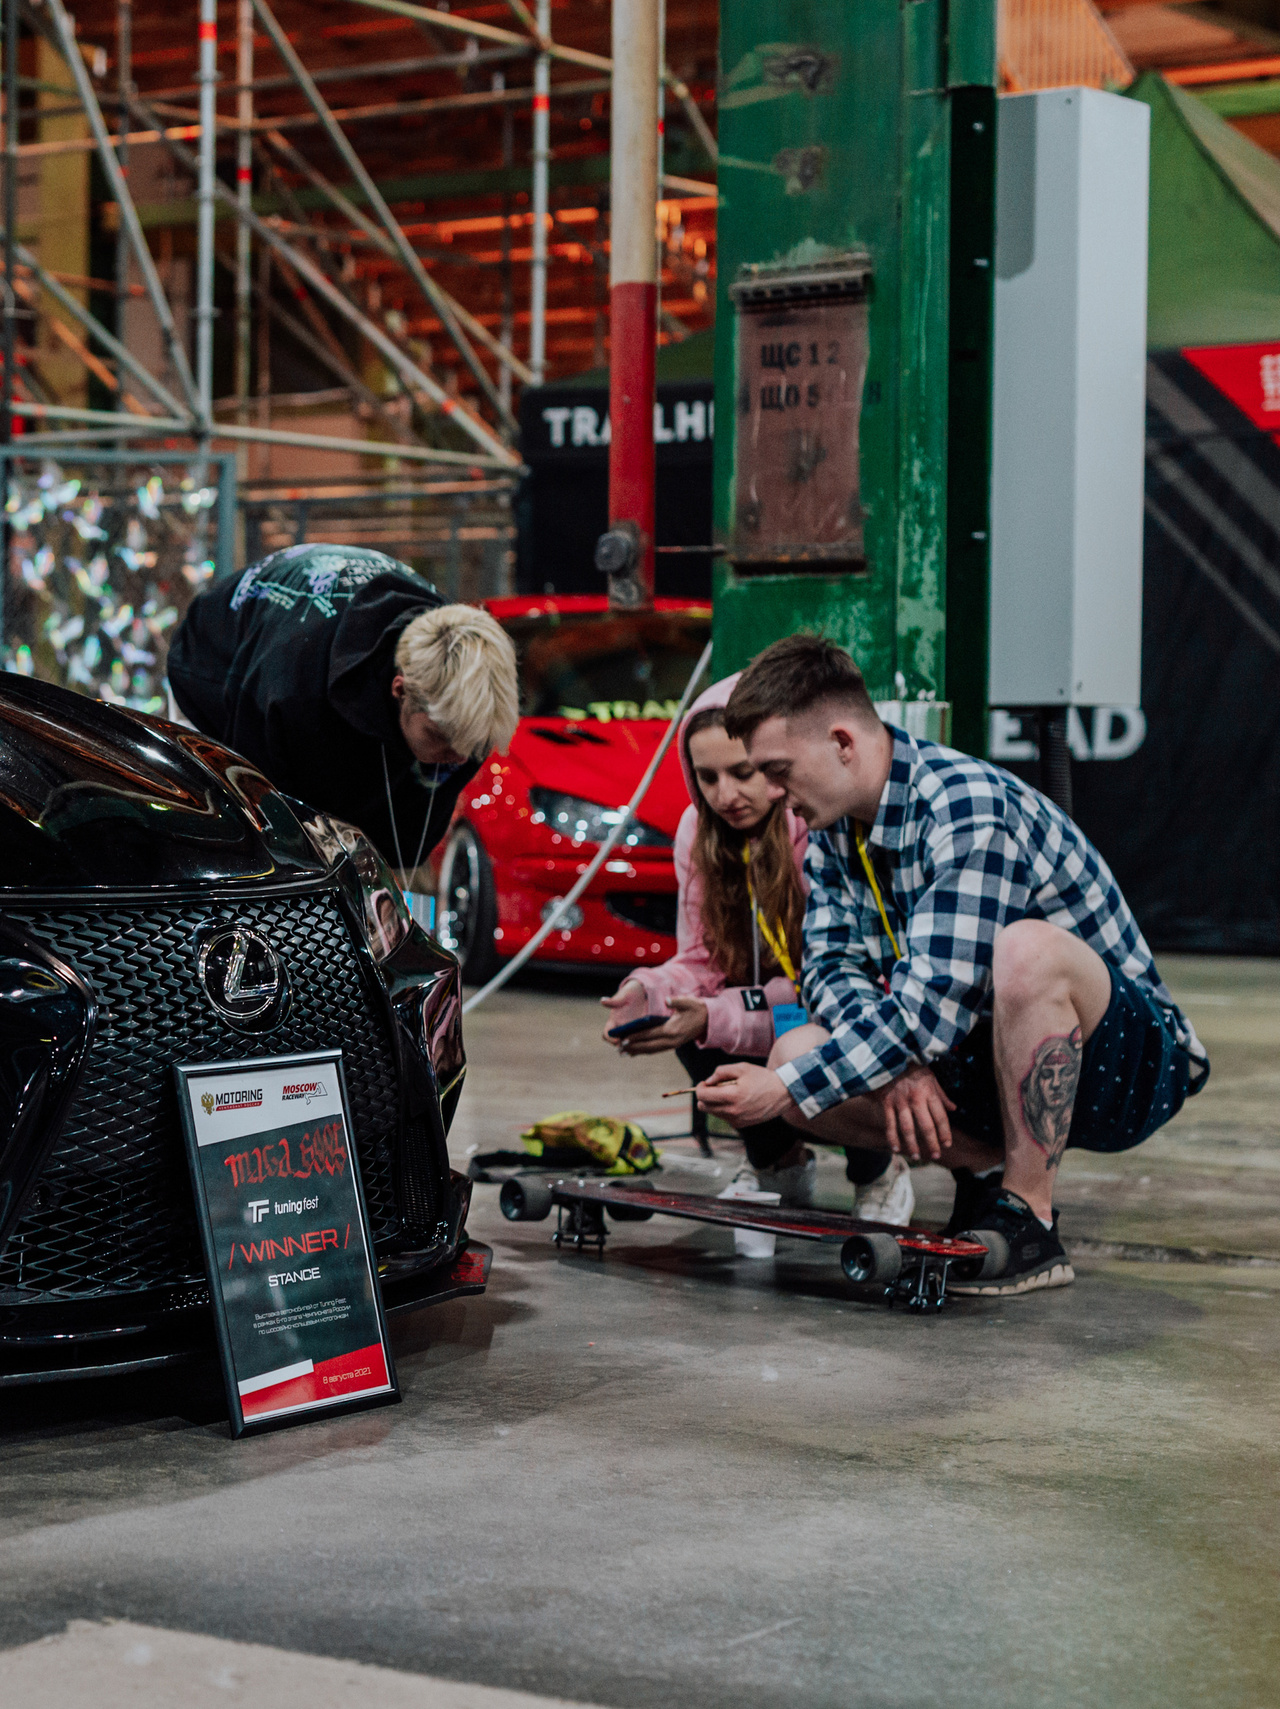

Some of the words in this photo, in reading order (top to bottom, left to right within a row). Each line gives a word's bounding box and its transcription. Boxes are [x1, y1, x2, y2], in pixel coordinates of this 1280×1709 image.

[282, 1082, 318, 1095] MOSCOW
[215, 1088, 263, 1106] MOTORING
[282, 1093, 305, 1101] RACEWAY
[268, 1266, 321, 1287] STANCE
[354, 1366, 372, 1378] 2021
